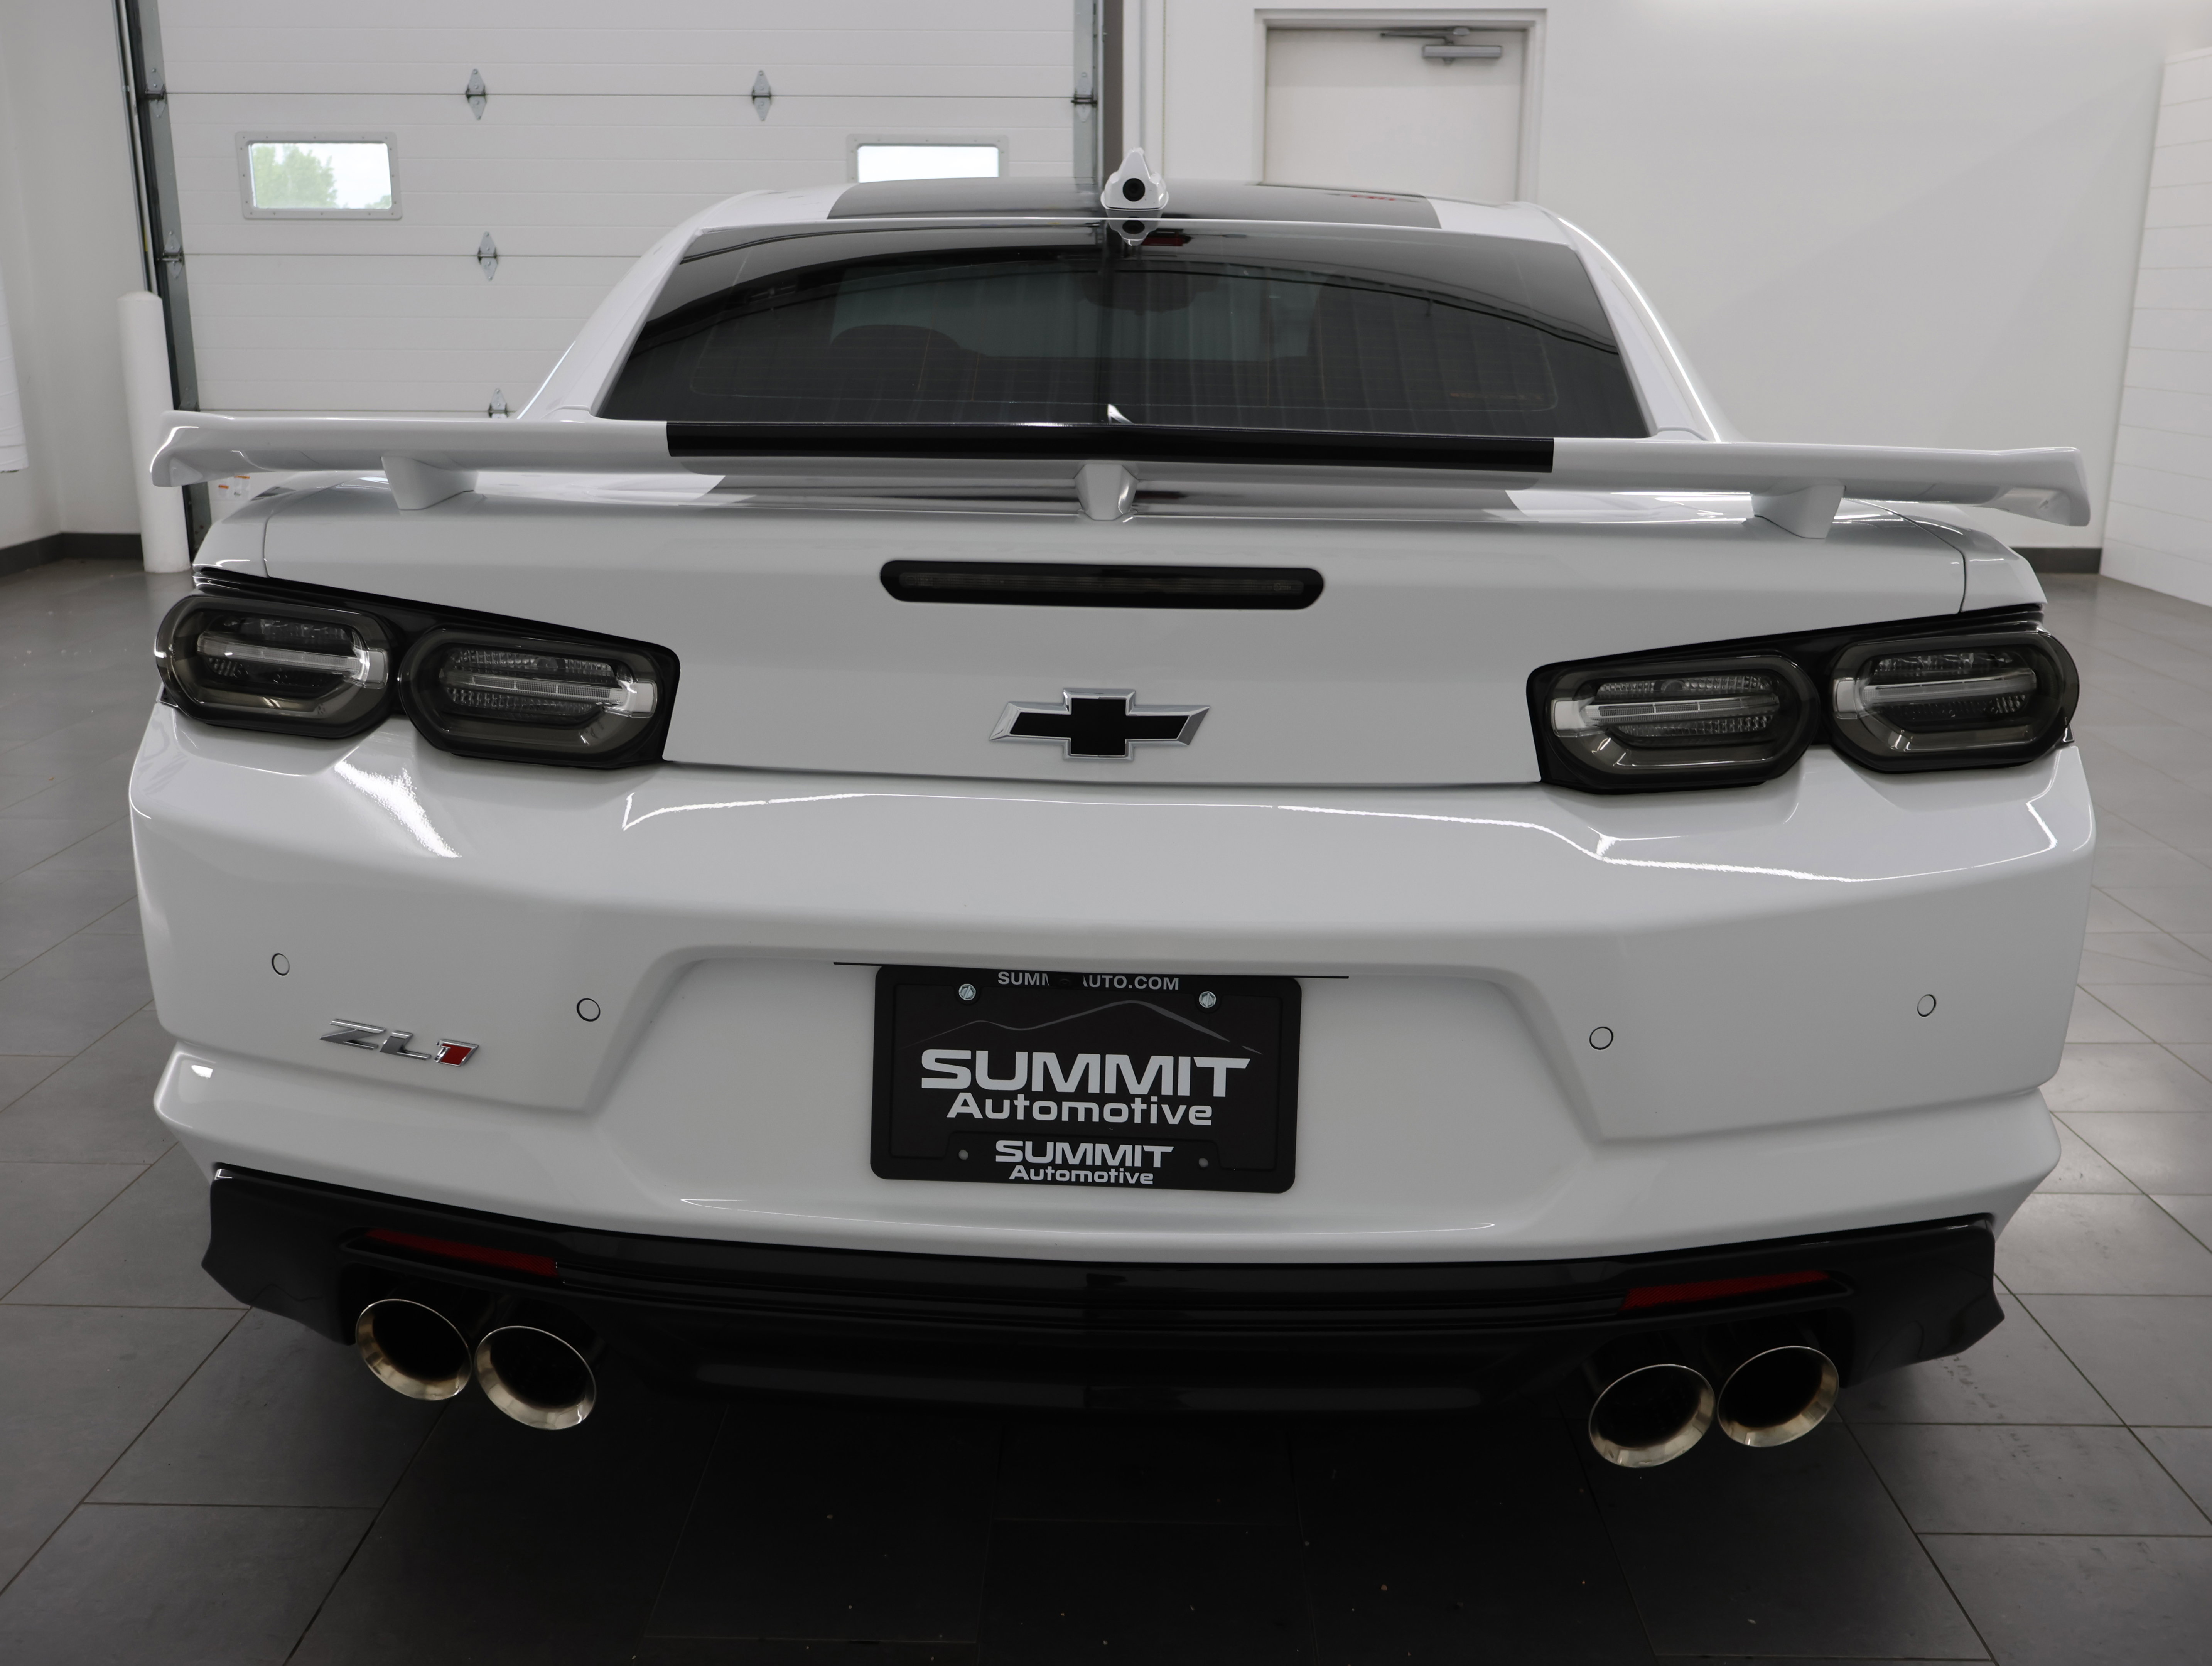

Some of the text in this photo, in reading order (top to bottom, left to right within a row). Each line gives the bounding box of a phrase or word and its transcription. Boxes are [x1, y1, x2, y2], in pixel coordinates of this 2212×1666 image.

[319, 1018, 479, 1067] ZL1
[921, 1049, 1250, 1098] SUMMIT
[947, 1092, 1212, 1126] Automotive
[995, 1140, 1174, 1168] SUMMIT
[1009, 1164, 1153, 1185] Automotive
